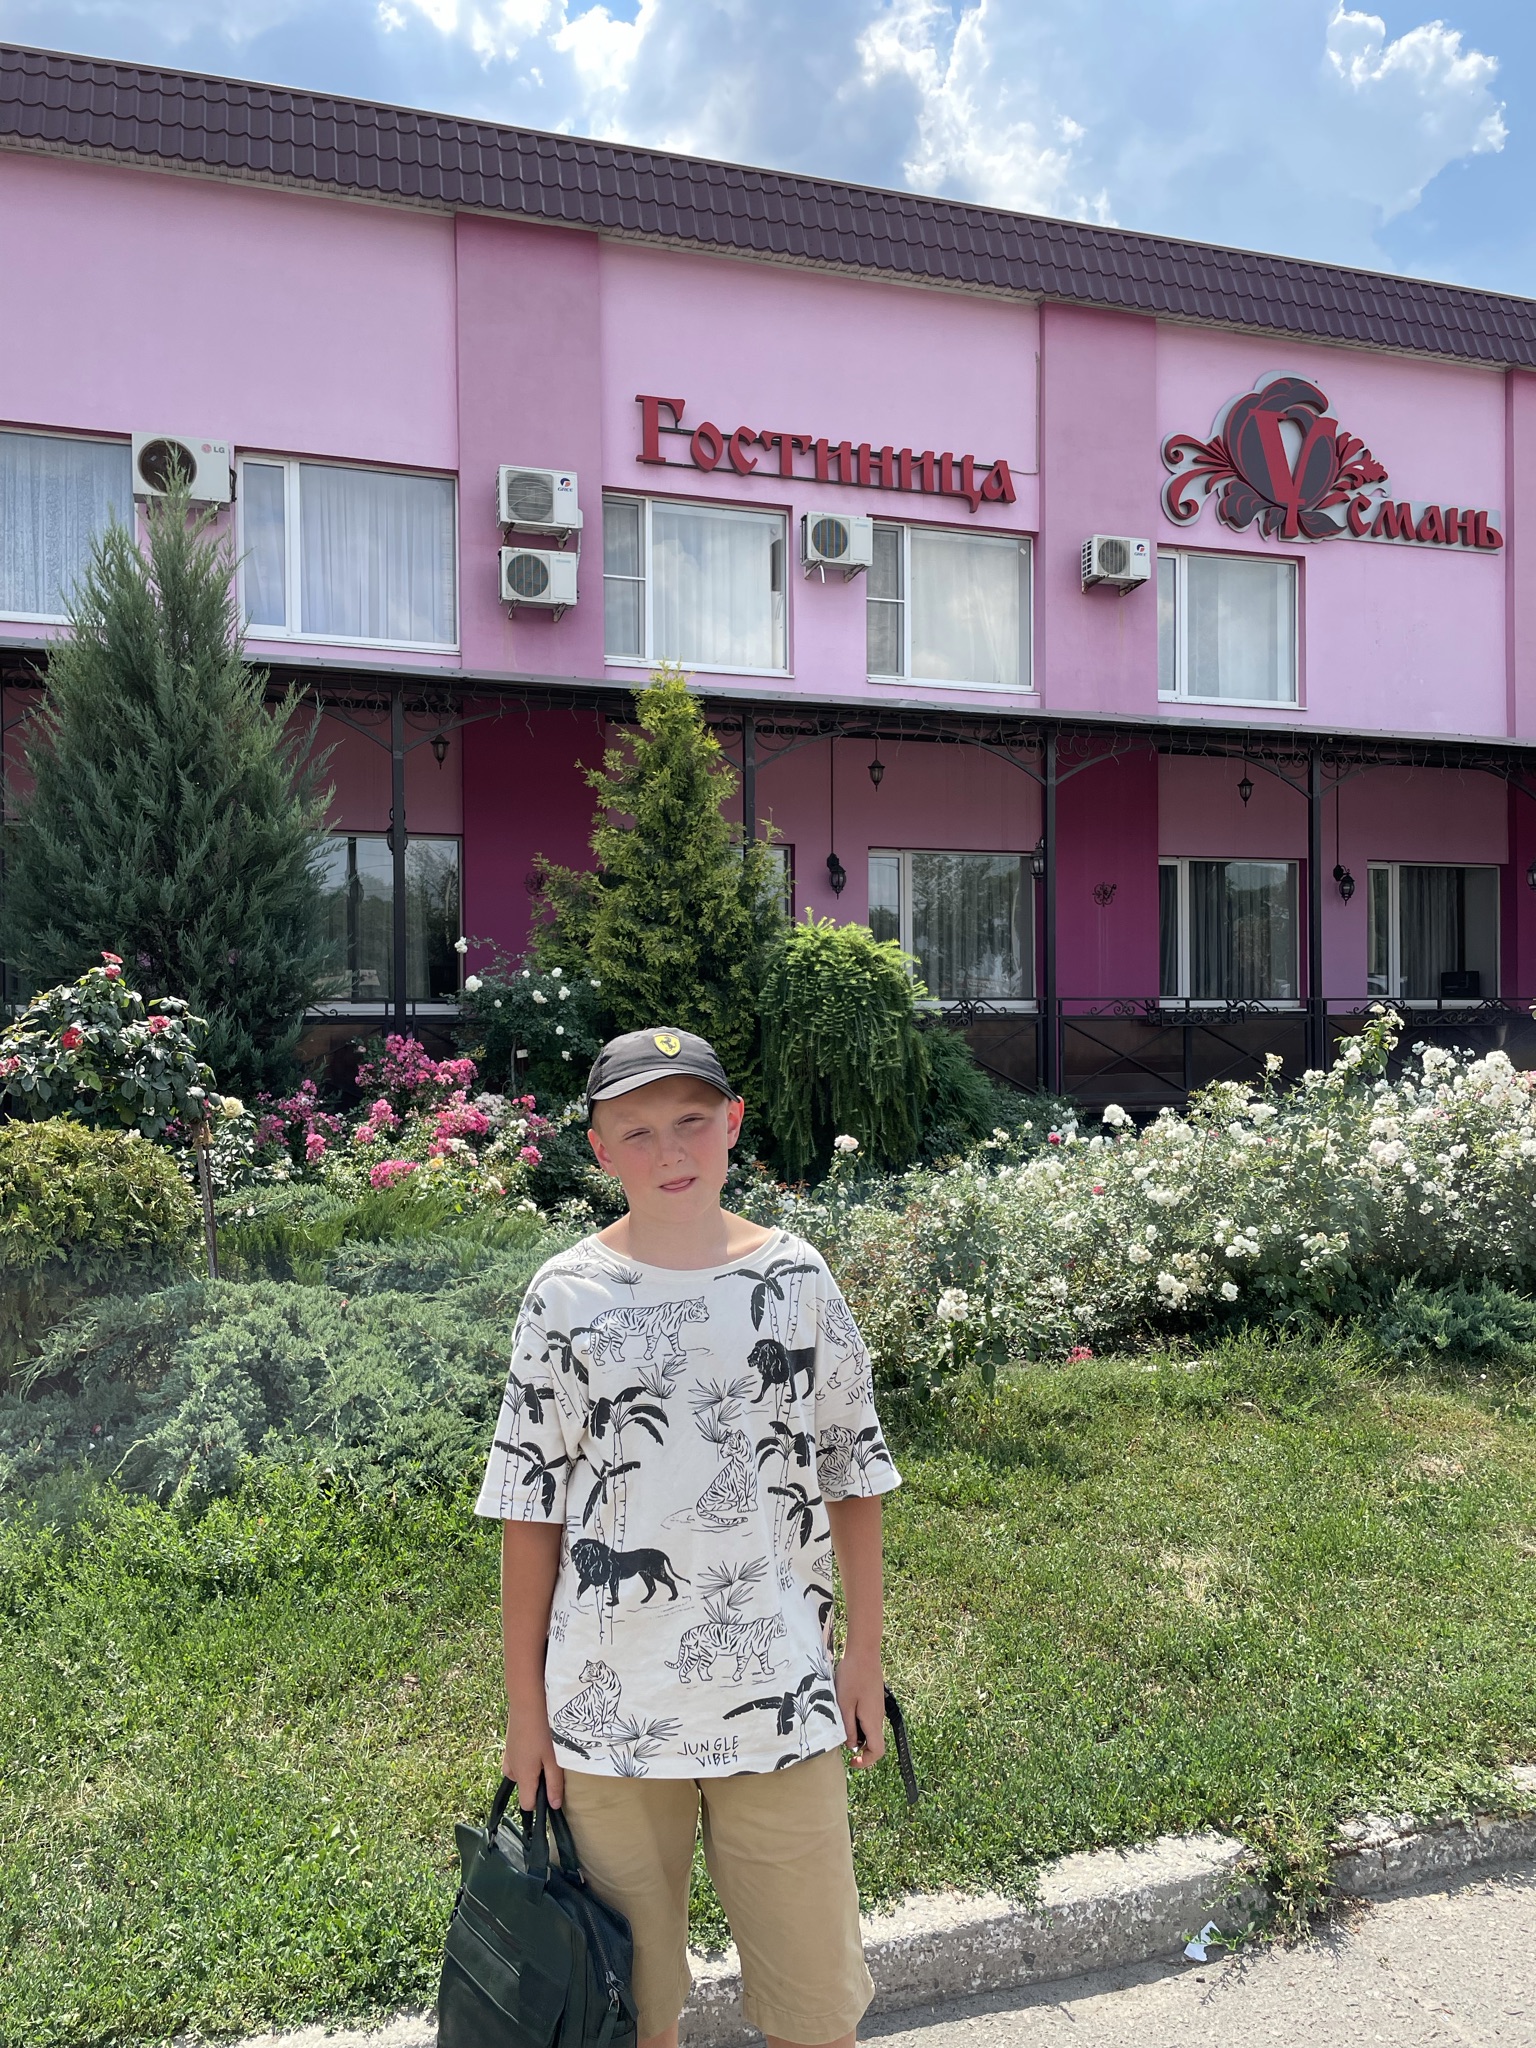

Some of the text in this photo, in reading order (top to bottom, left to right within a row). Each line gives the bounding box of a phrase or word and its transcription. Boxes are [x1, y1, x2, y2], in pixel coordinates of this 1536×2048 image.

[213, 446, 226, 454] LG
[635, 394, 1017, 514] Гостиница
[676, 1735, 739, 1756] JUNGLE
[695, 1750, 738, 1768] VIBES
